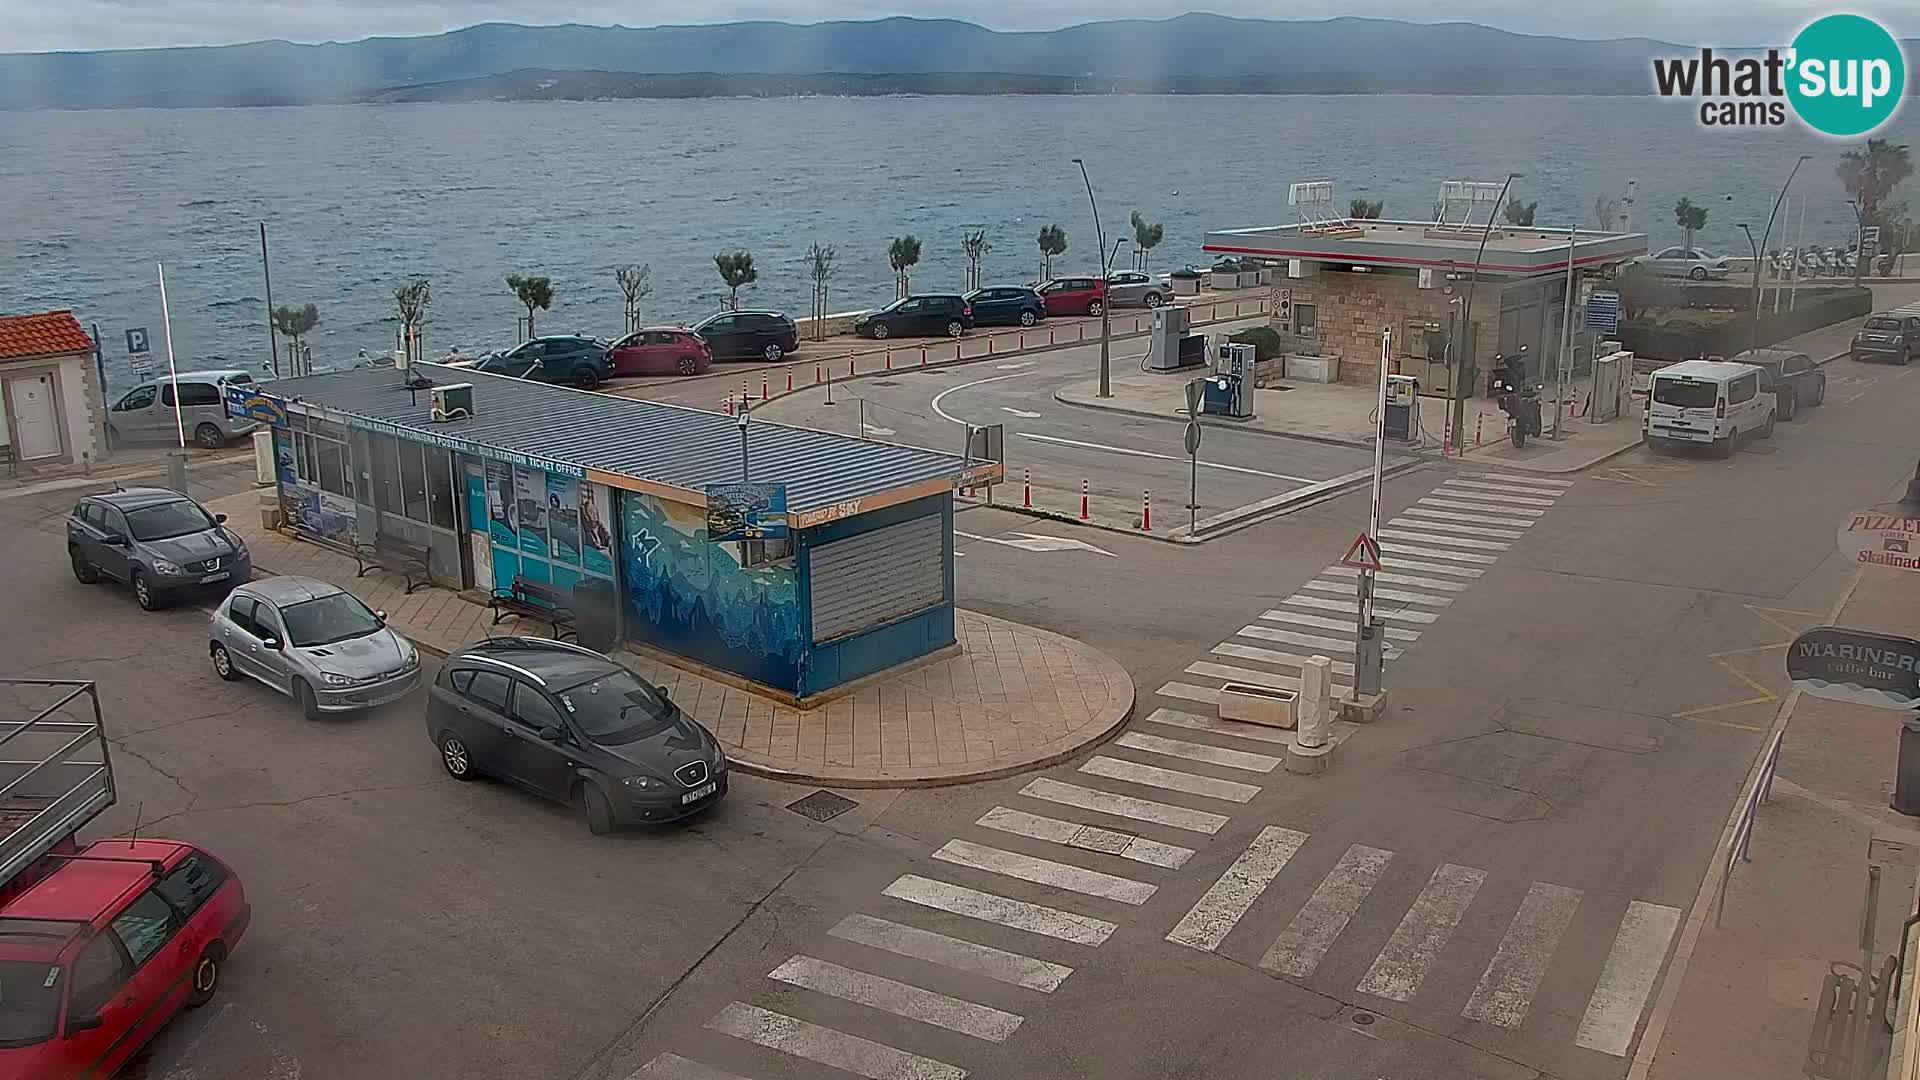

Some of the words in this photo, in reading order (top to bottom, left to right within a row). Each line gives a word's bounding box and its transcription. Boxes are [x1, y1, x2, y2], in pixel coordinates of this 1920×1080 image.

[131, 331, 144, 350] P
[437, 436, 468, 452] POSTAJA
[494, 450, 527, 466] STATION
[528, 457, 555, 472] TICKET
[555, 463, 583, 477] OFFICE
[1868, 666, 1896, 680] bar
